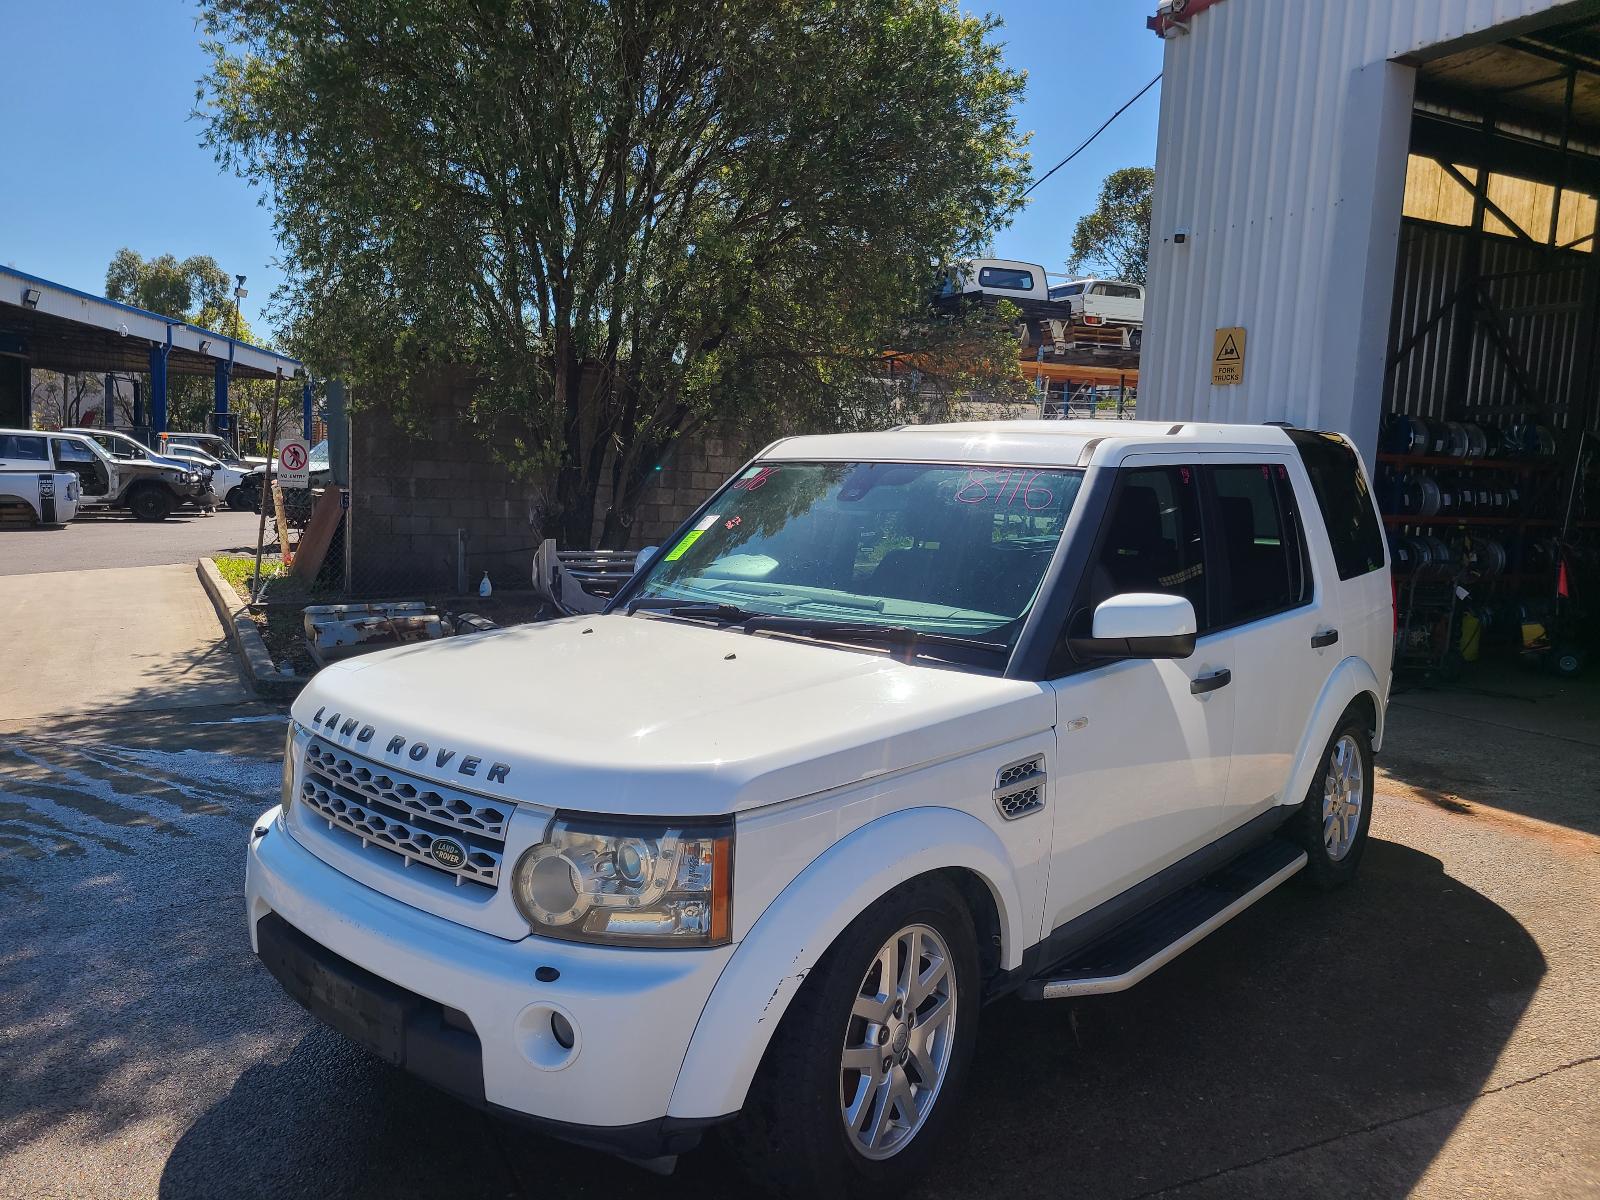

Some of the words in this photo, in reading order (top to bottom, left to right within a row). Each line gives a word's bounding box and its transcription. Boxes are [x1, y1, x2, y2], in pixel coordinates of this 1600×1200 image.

[1214, 374, 1240, 382] TRUCKS
[956, 468, 1053, 510] 8916
[313, 705, 376, 743] LAND
[385, 734, 511, 784] ROVER
[437, 843, 455, 853] LAND
[439, 850, 460, 863] ROVER
